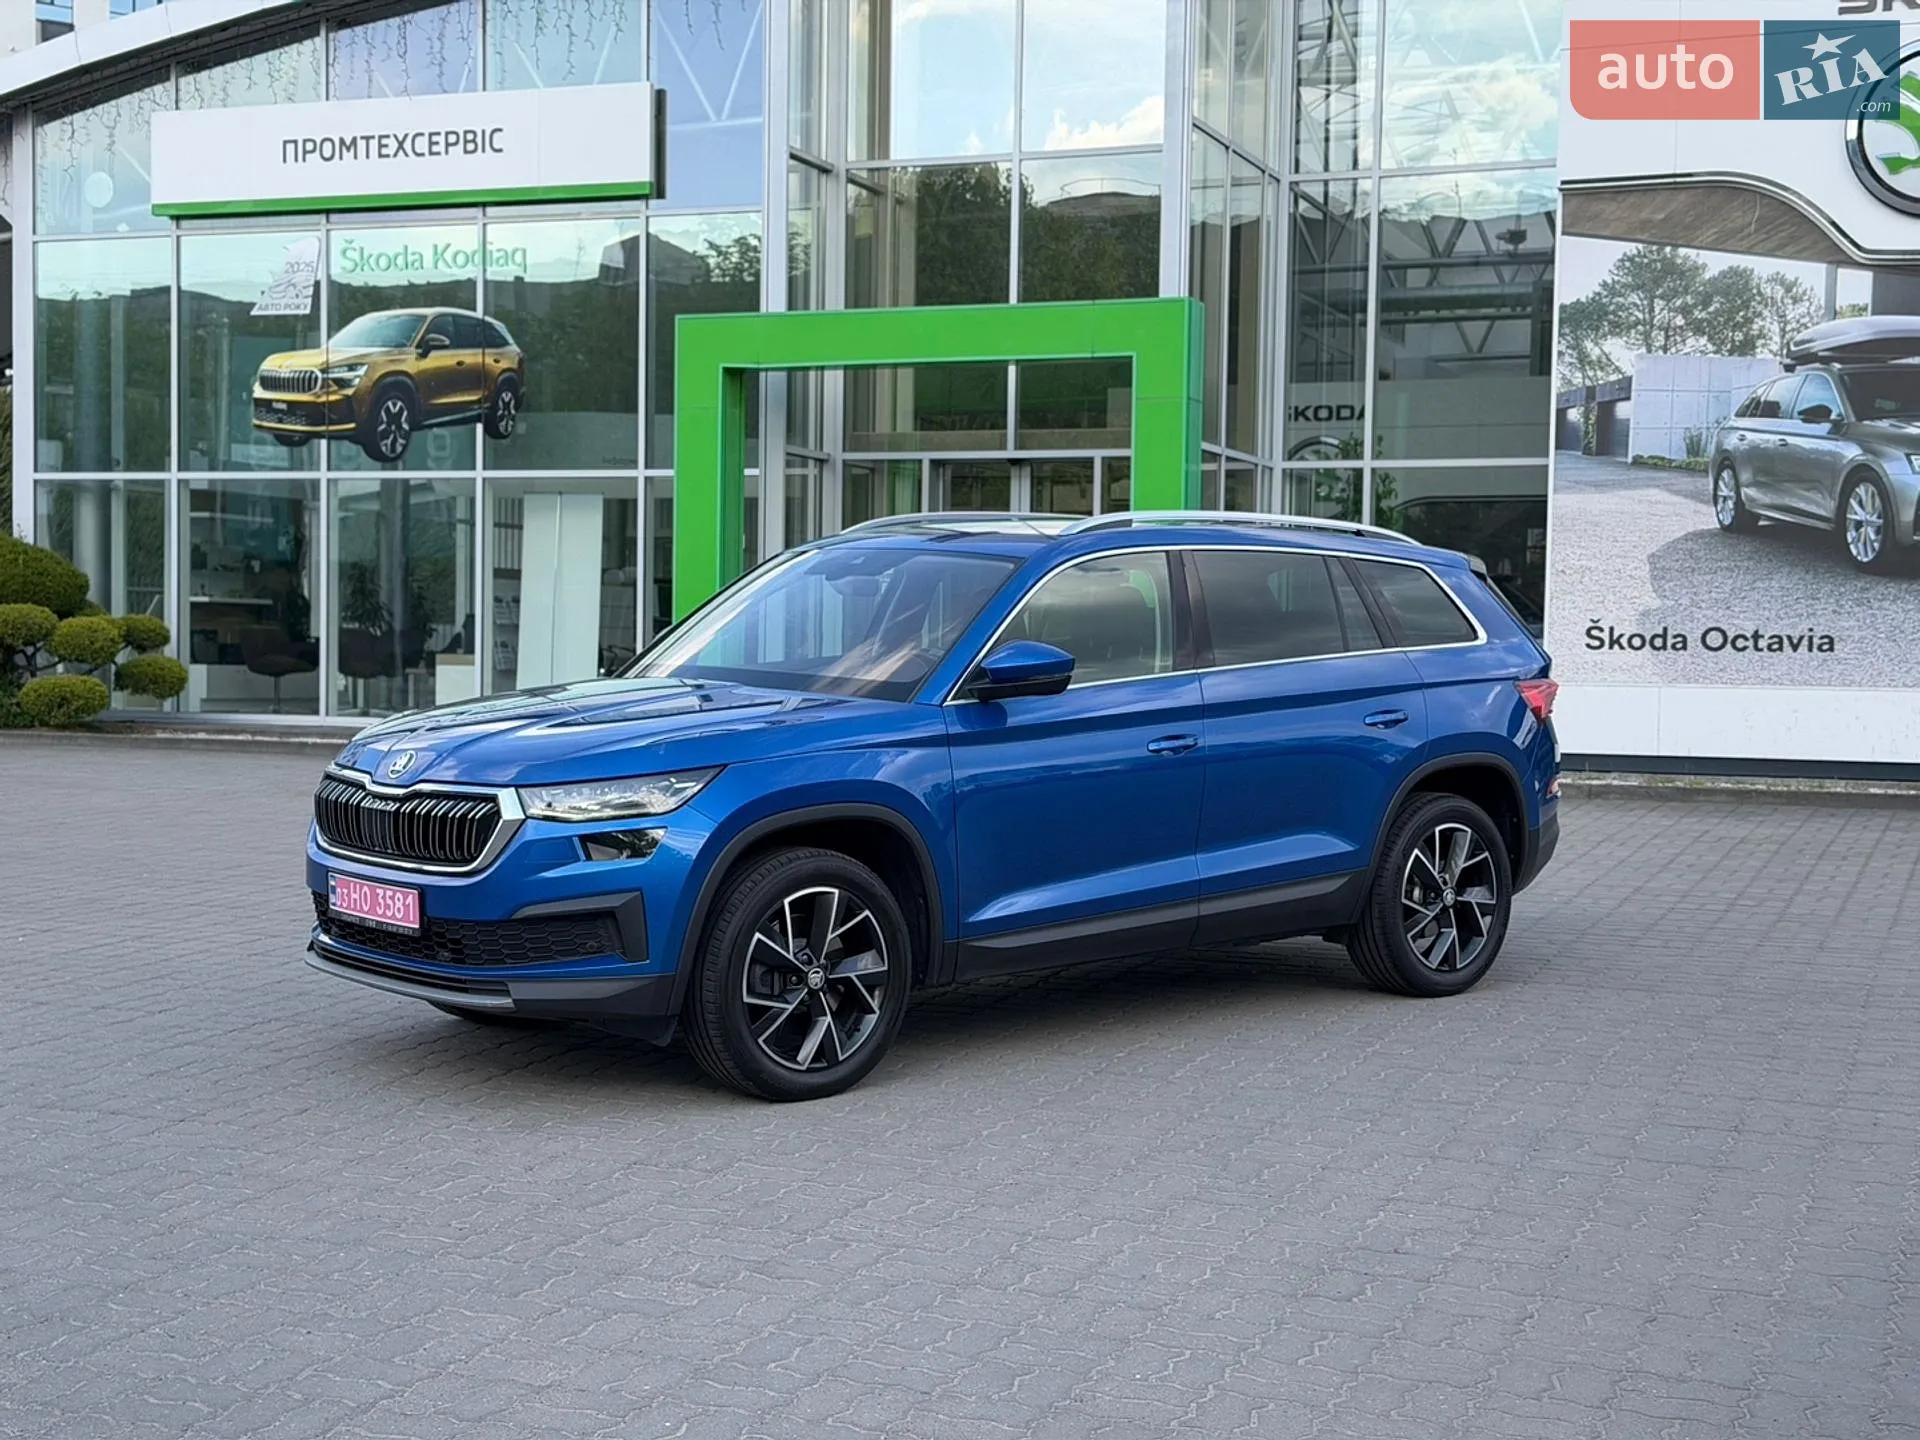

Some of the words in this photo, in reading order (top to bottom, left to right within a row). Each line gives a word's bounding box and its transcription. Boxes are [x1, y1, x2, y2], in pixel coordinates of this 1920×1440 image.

[282, 127, 504, 164] ПРОМТЕХСЕРВІС
[340, 238, 424, 274] Škoda
[432, 240, 528, 274] Kodiaq
[1585, 618, 1688, 651] Škoda
[1700, 626, 1835, 653] Octavia
[376, 888, 414, 921] 3581
